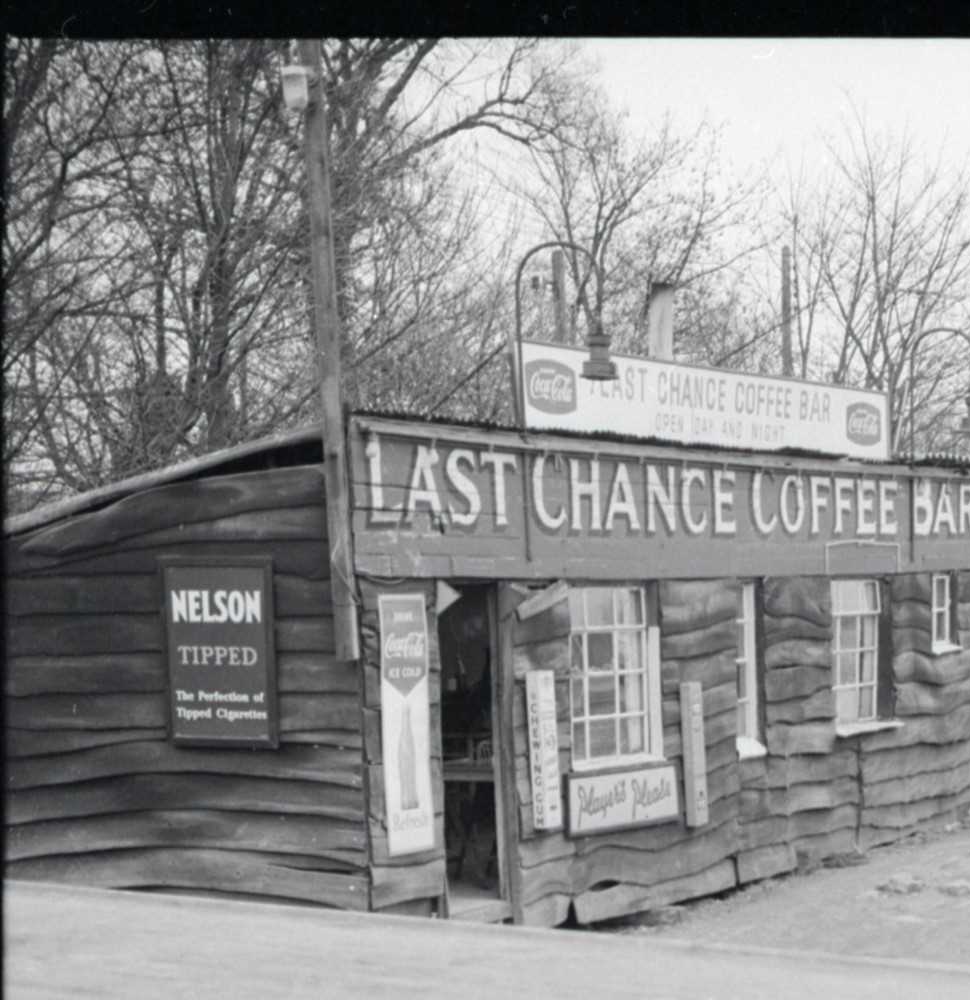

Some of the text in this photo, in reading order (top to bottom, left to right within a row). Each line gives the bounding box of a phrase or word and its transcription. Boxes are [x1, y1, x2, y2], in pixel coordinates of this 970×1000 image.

[658, 370, 726, 412] CHANCE
[735, 381, 792, 420] COFFEE
[799, 390, 831, 422] BAR
[655, 412, 684, 433] OPEN
[722, 420, 743, 440] AND
[366, 441, 518, 526] LAST
[532, 454, 737, 534] CHANCE
[752, 471, 898, 535] COFFEE
[171, 589, 262, 623] NELSON
[177, 645, 259, 666] TIPPED
[175, 690, 265, 703] The Perfection of
[176, 706, 268, 722] Tipped Cigarettes
